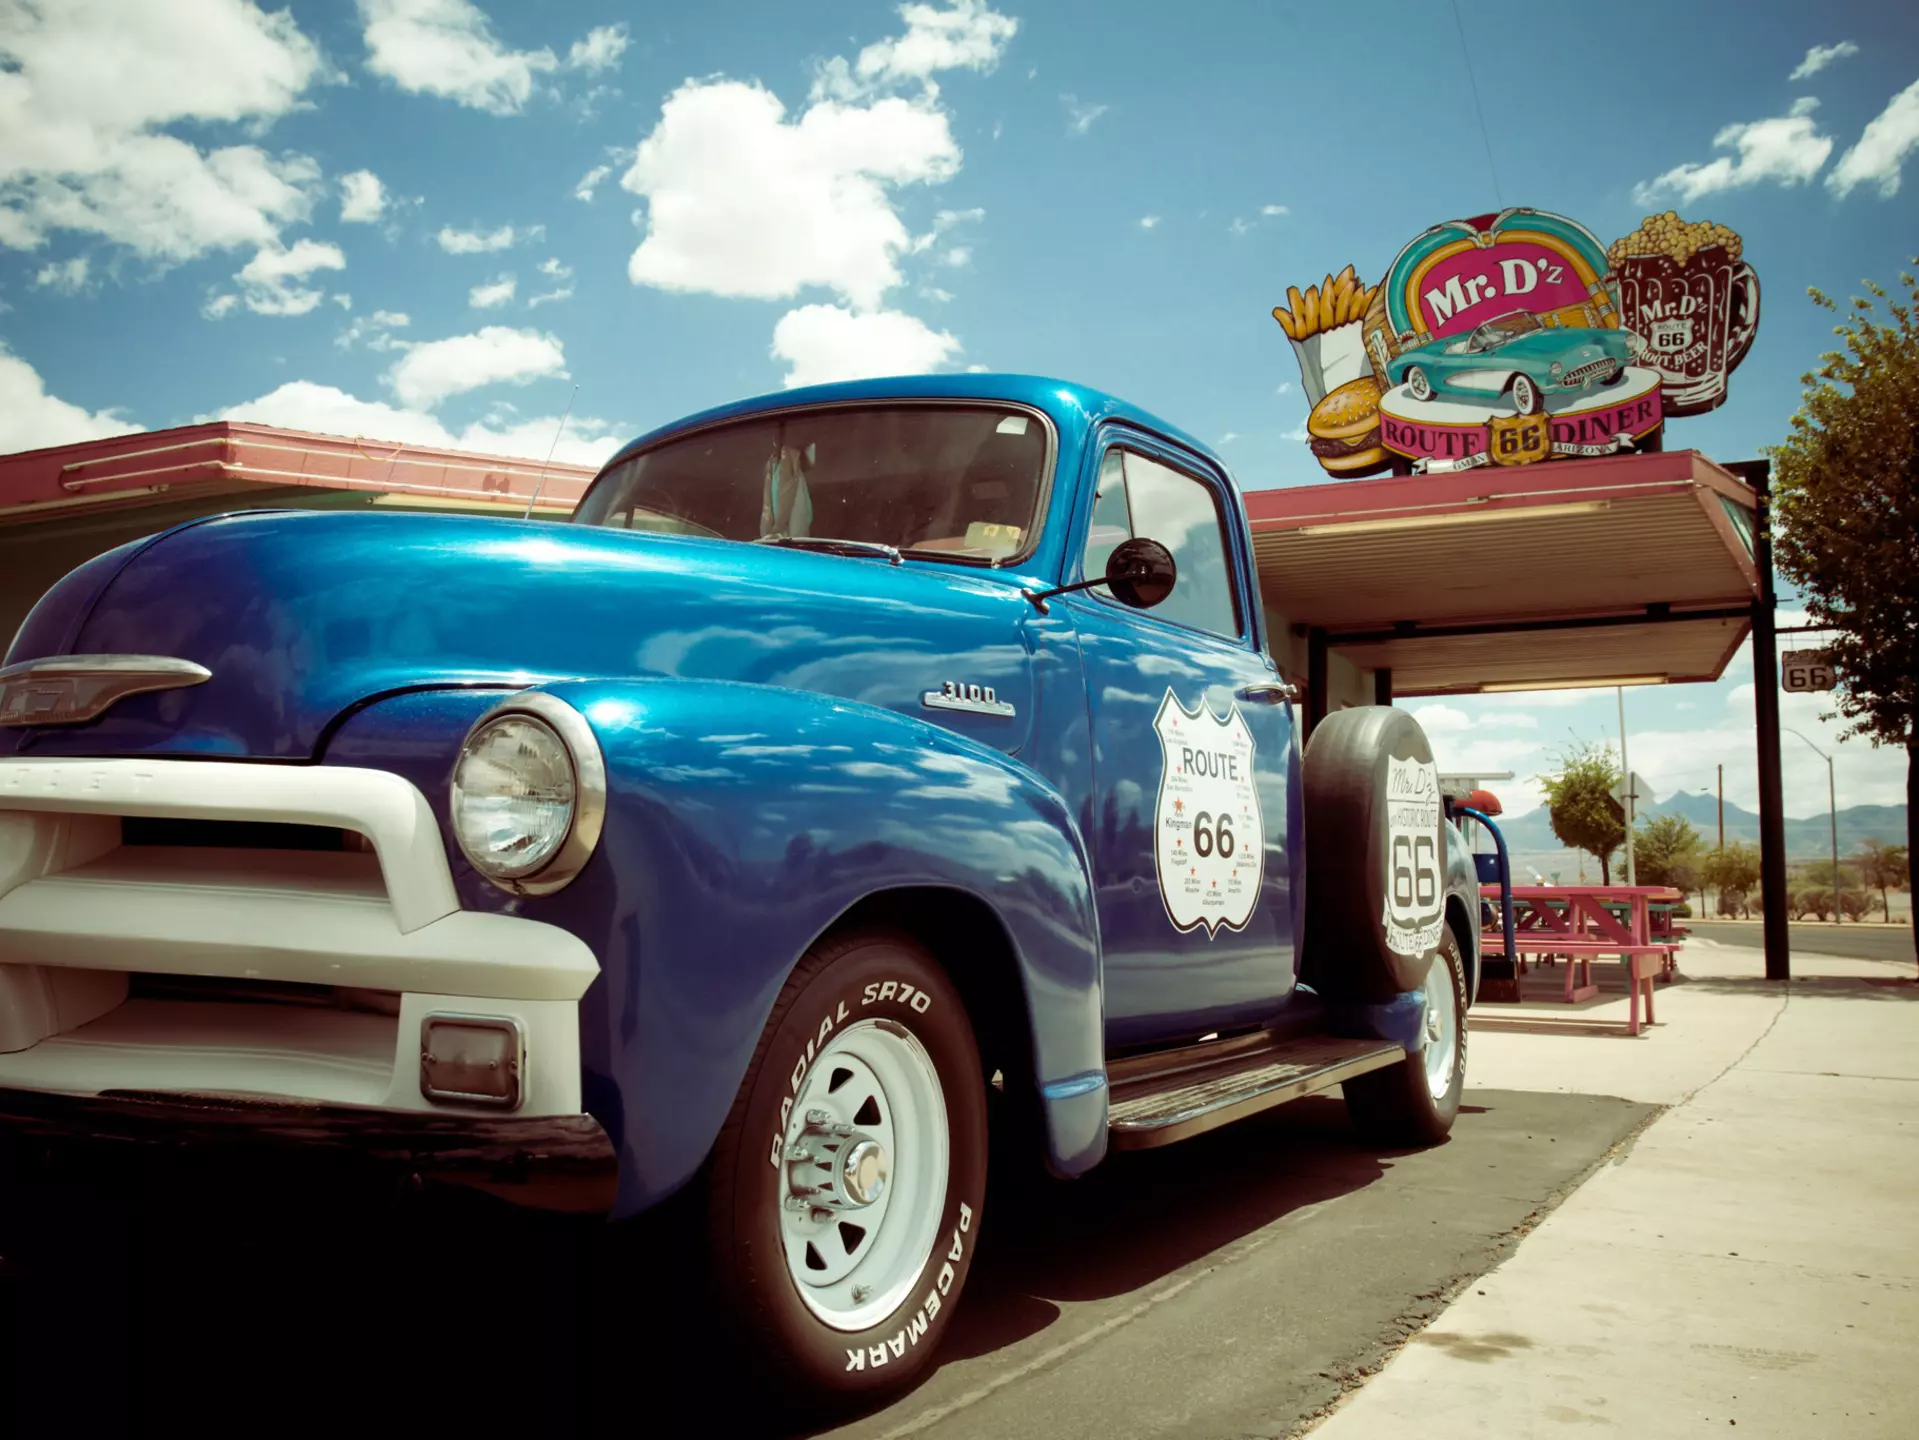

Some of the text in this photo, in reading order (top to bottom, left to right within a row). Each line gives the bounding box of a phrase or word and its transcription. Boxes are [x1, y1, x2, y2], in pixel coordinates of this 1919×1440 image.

[1424, 270, 1496, 329] Mr.
[1640, 300, 1677, 324] Mr.
[1657, 322, 1687, 331] ROUTE
[1658, 332, 1685, 348] 66
[1674, 341, 1708, 366] BEER
[1384, 400, 1654, 457] ROUTE 66 DINER
[1452, 442, 1613, 472] GMAN ARIZONA
[1788, 666, 1828, 688] 66
[943, 680, 996, 705] 3100
[1182, 746, 1239, 782] ROUTE
[1391, 766, 1413, 795] Mr.
[1165, 816, 1192, 831] Kingman
[1193, 810, 1235, 859] 66
[1393, 834, 1435, 908] 66
[769, 980, 932, 1170] RADIAL SR70
[845, 1201, 974, 1373] PACEMARK
